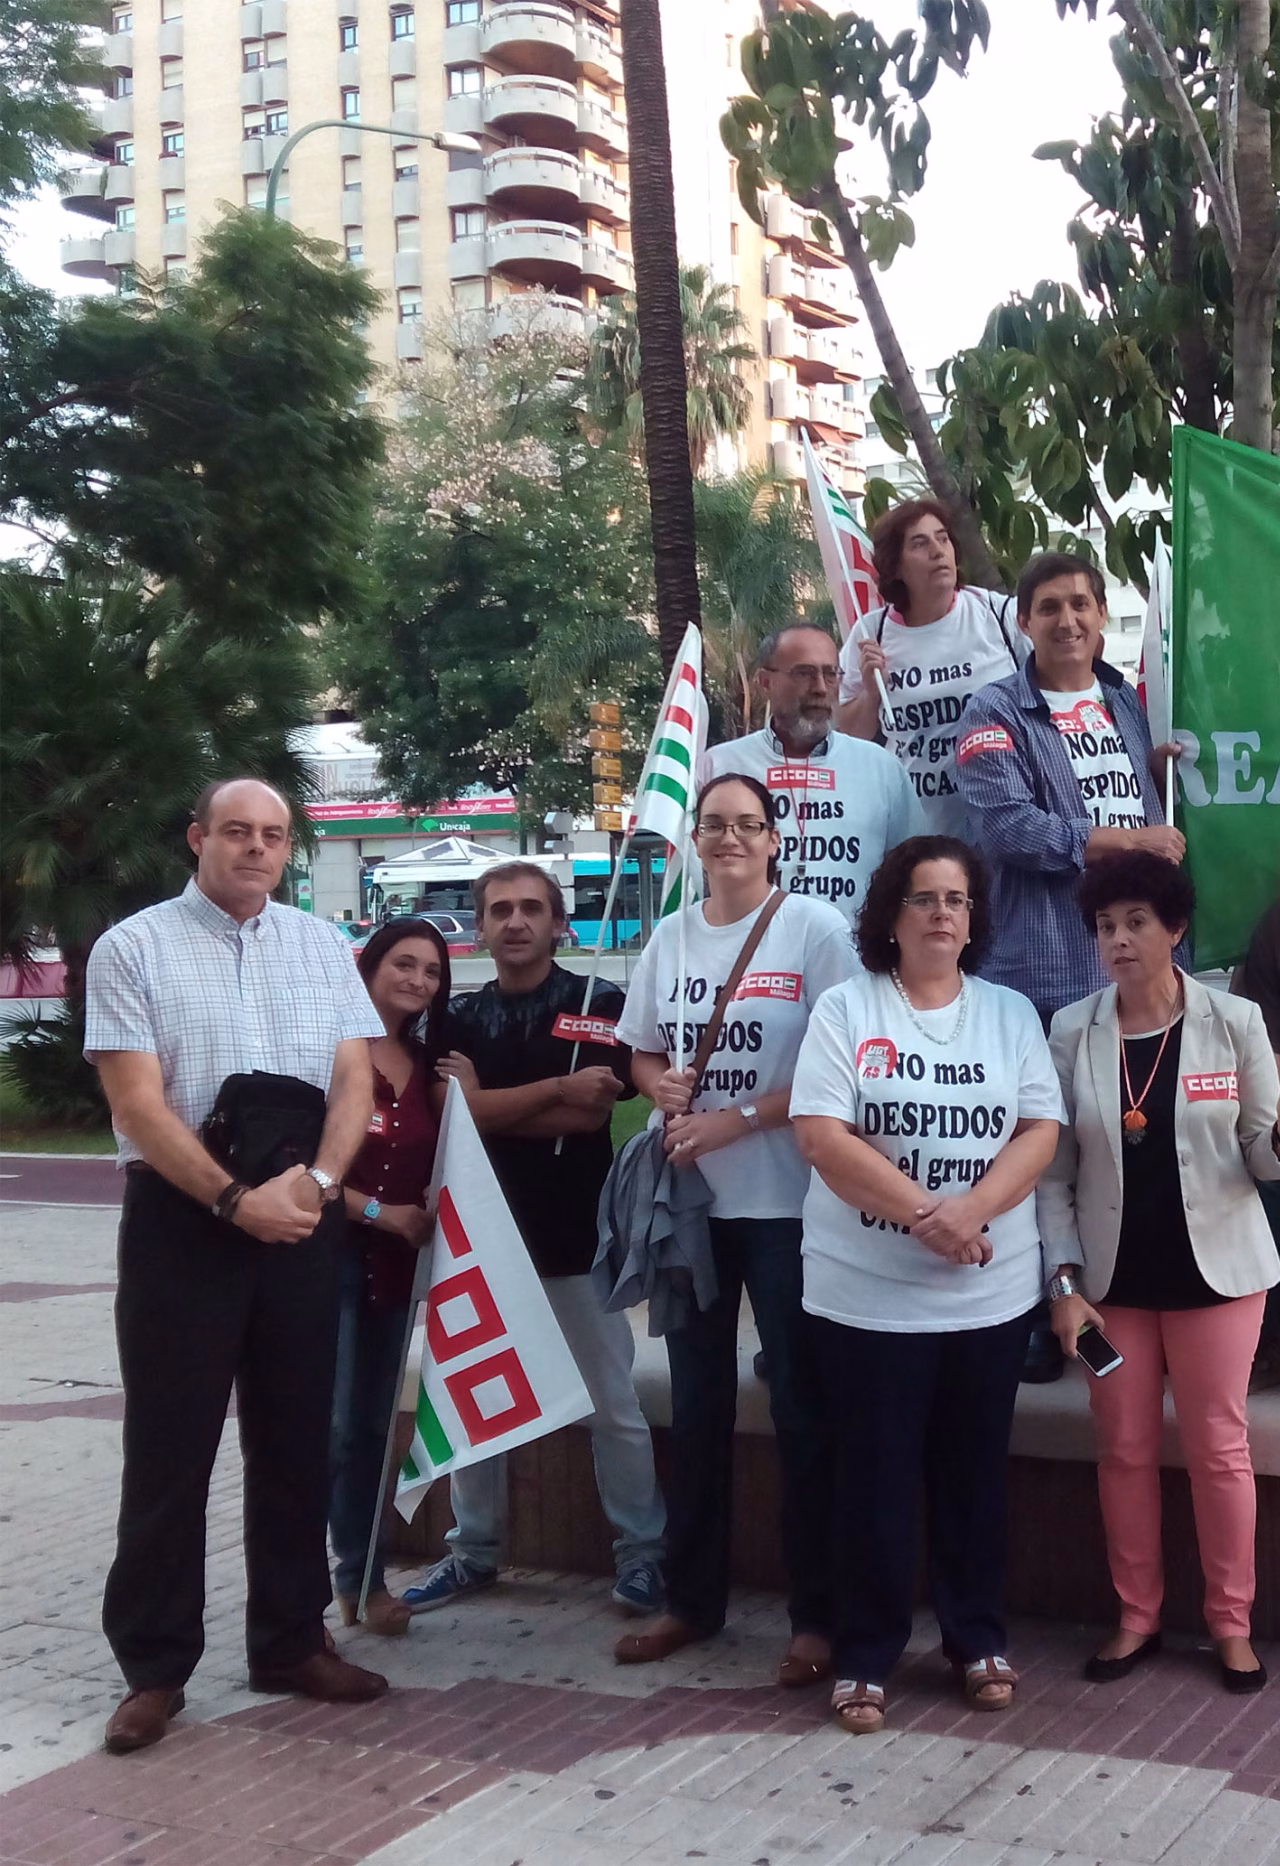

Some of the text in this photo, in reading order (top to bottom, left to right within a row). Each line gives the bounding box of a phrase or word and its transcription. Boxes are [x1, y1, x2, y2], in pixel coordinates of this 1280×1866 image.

[890, 662, 973, 692] NO mas
[883, 693, 973, 732] ESPID
[1064, 731, 1129, 760] NO ma
[1078, 770, 1142, 800] SPIDO
[774, 794, 844, 821] O mas
[439, 820, 471, 833] Unicaja
[789, 876, 856, 903] grupo
[697, 1069, 758, 1098] rupo
[886, 1053, 986, 1086] NO mas
[864, 1101, 1007, 1139] DESPIDOS
